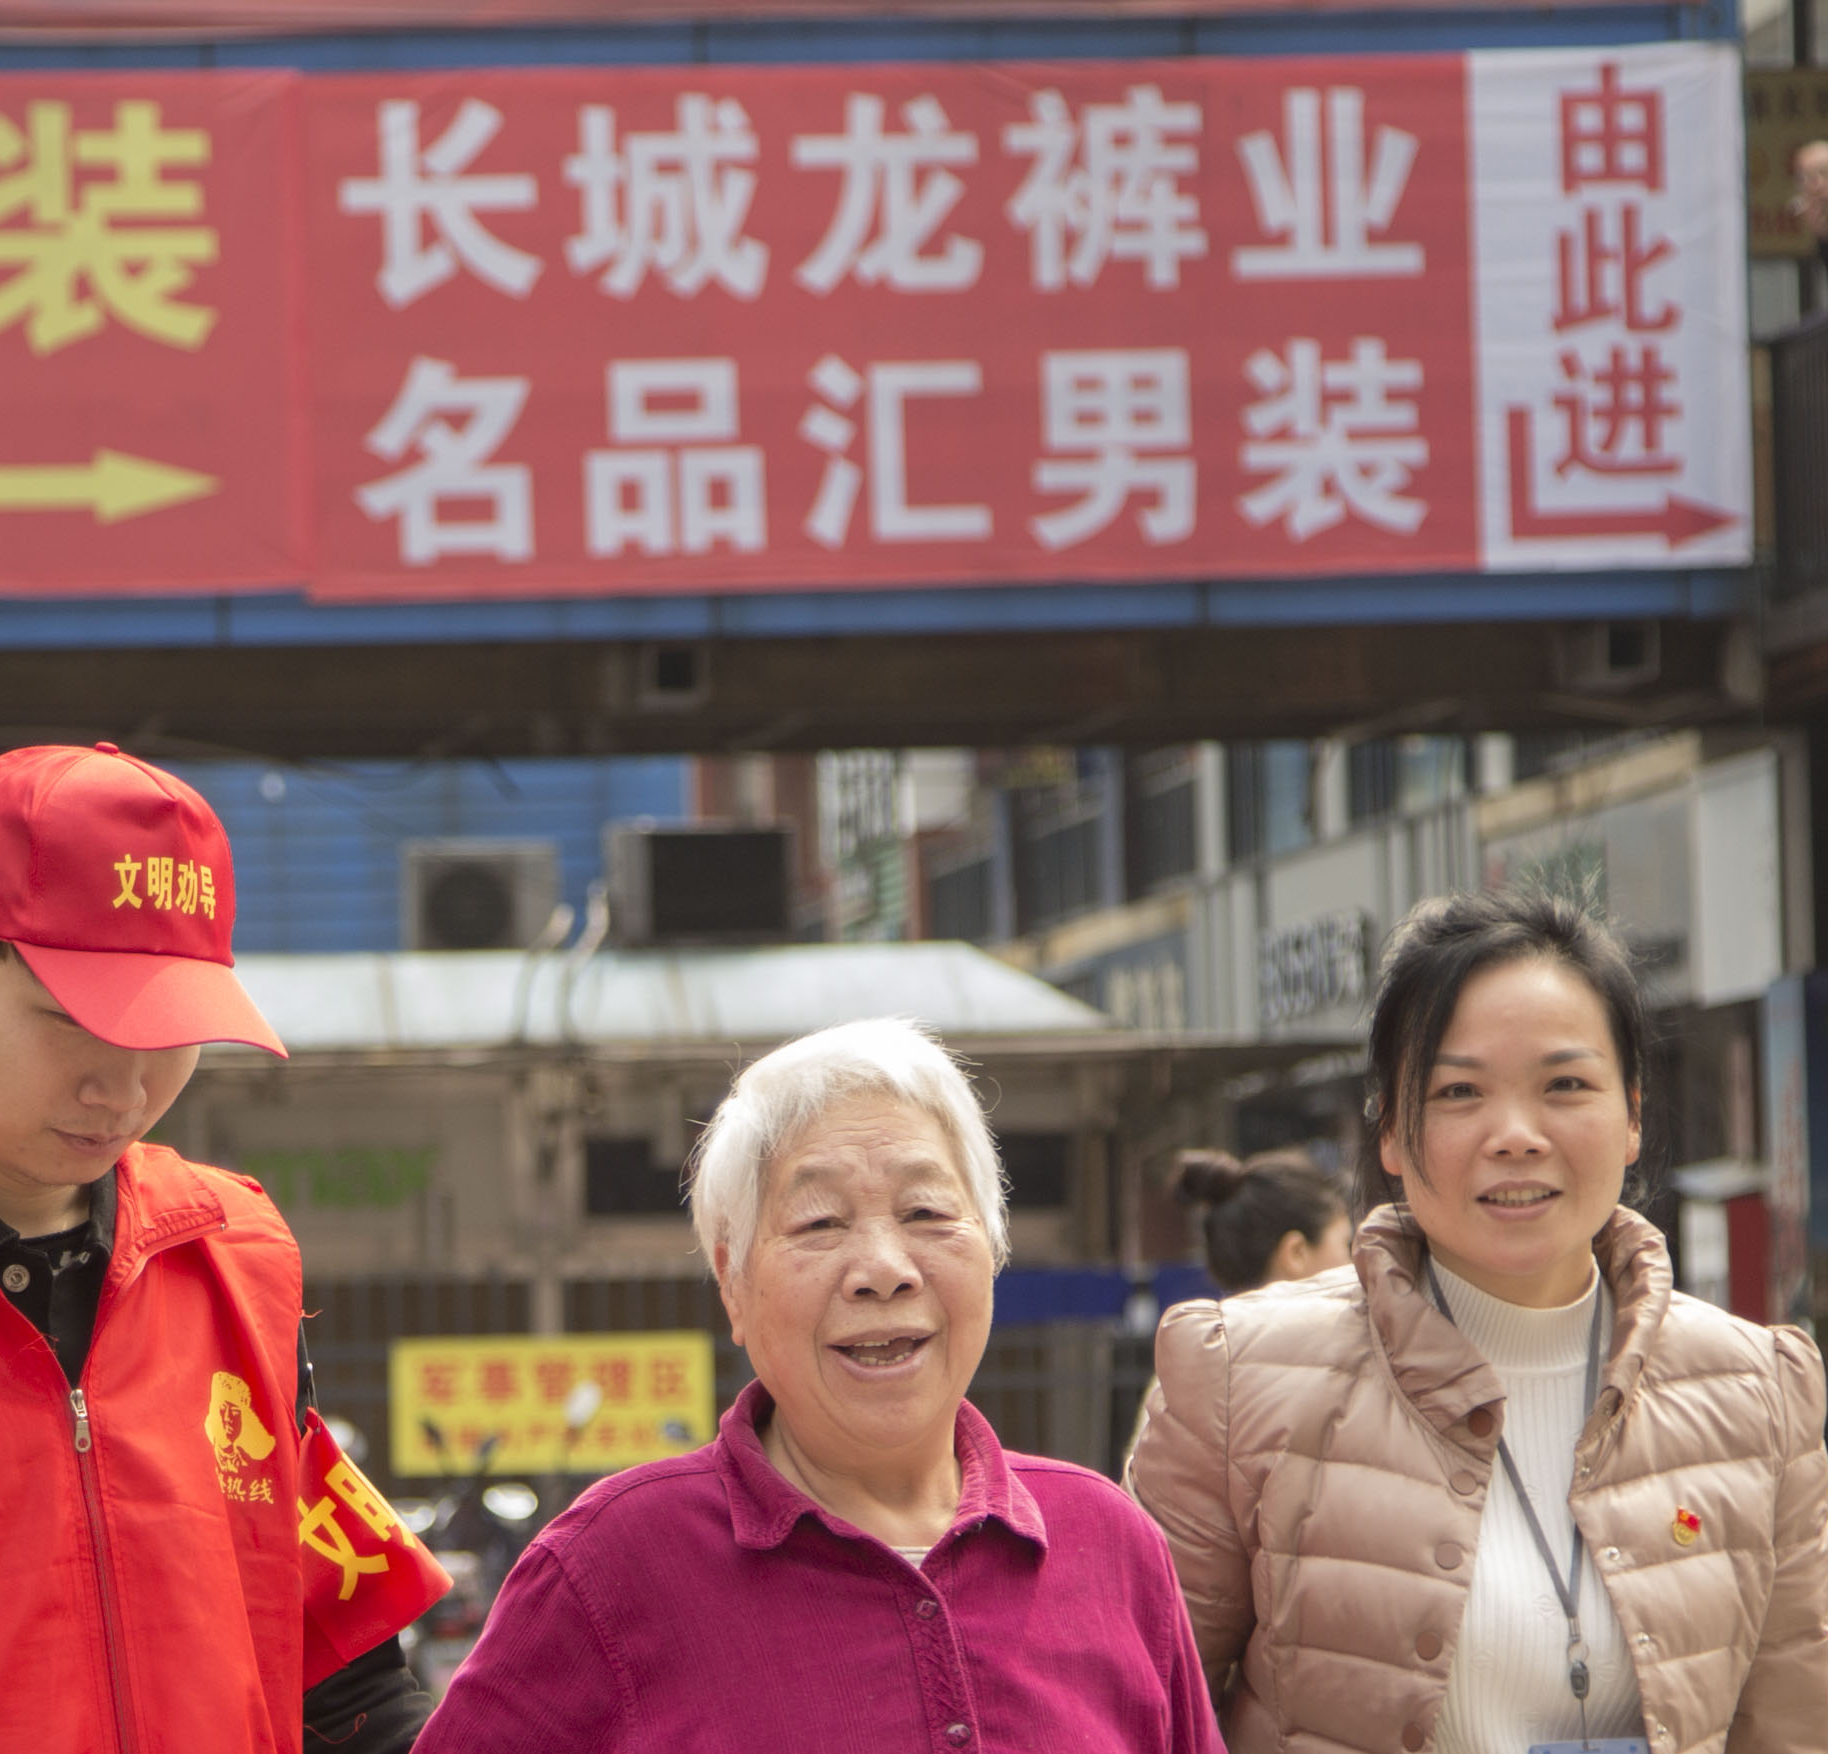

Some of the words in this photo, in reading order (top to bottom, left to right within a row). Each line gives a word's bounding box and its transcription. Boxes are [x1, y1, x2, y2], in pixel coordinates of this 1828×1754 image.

[338, 84, 1426, 309] 长城龙裤业
[1550, 62, 1683, 482] 由此进
[355, 336, 1431, 566] 名品汇男装
[111, 852, 217, 921] 文明劝导
